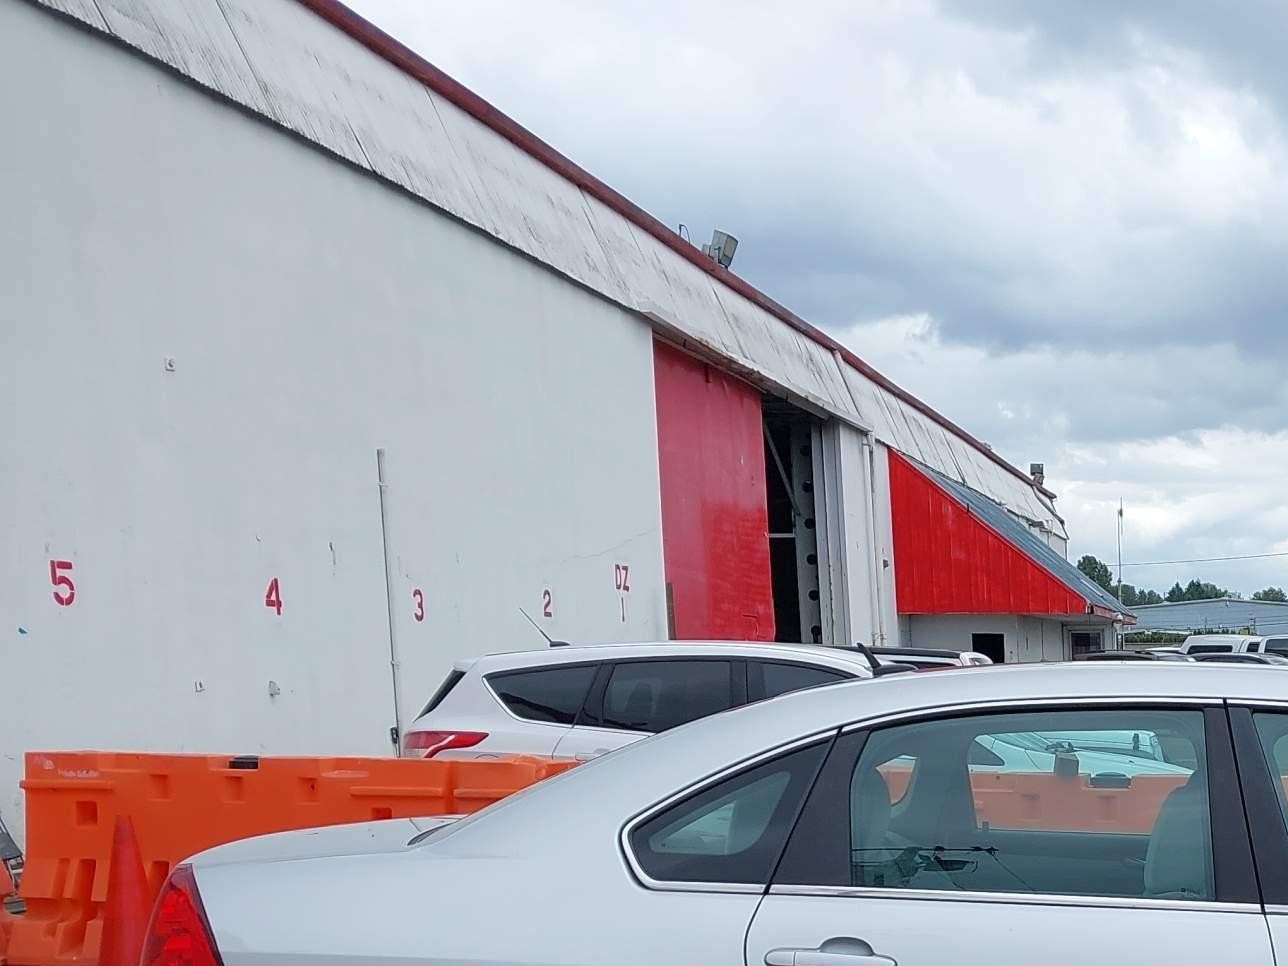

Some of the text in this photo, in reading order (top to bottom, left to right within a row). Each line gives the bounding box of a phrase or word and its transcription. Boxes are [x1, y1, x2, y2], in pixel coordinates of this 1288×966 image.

[49, 559, 76, 607] 5
[615, 563, 630, 592] DZ
[265, 577, 282, 616] 4
[413, 588, 424, 622] 3
[543, 589, 552, 618] 2
